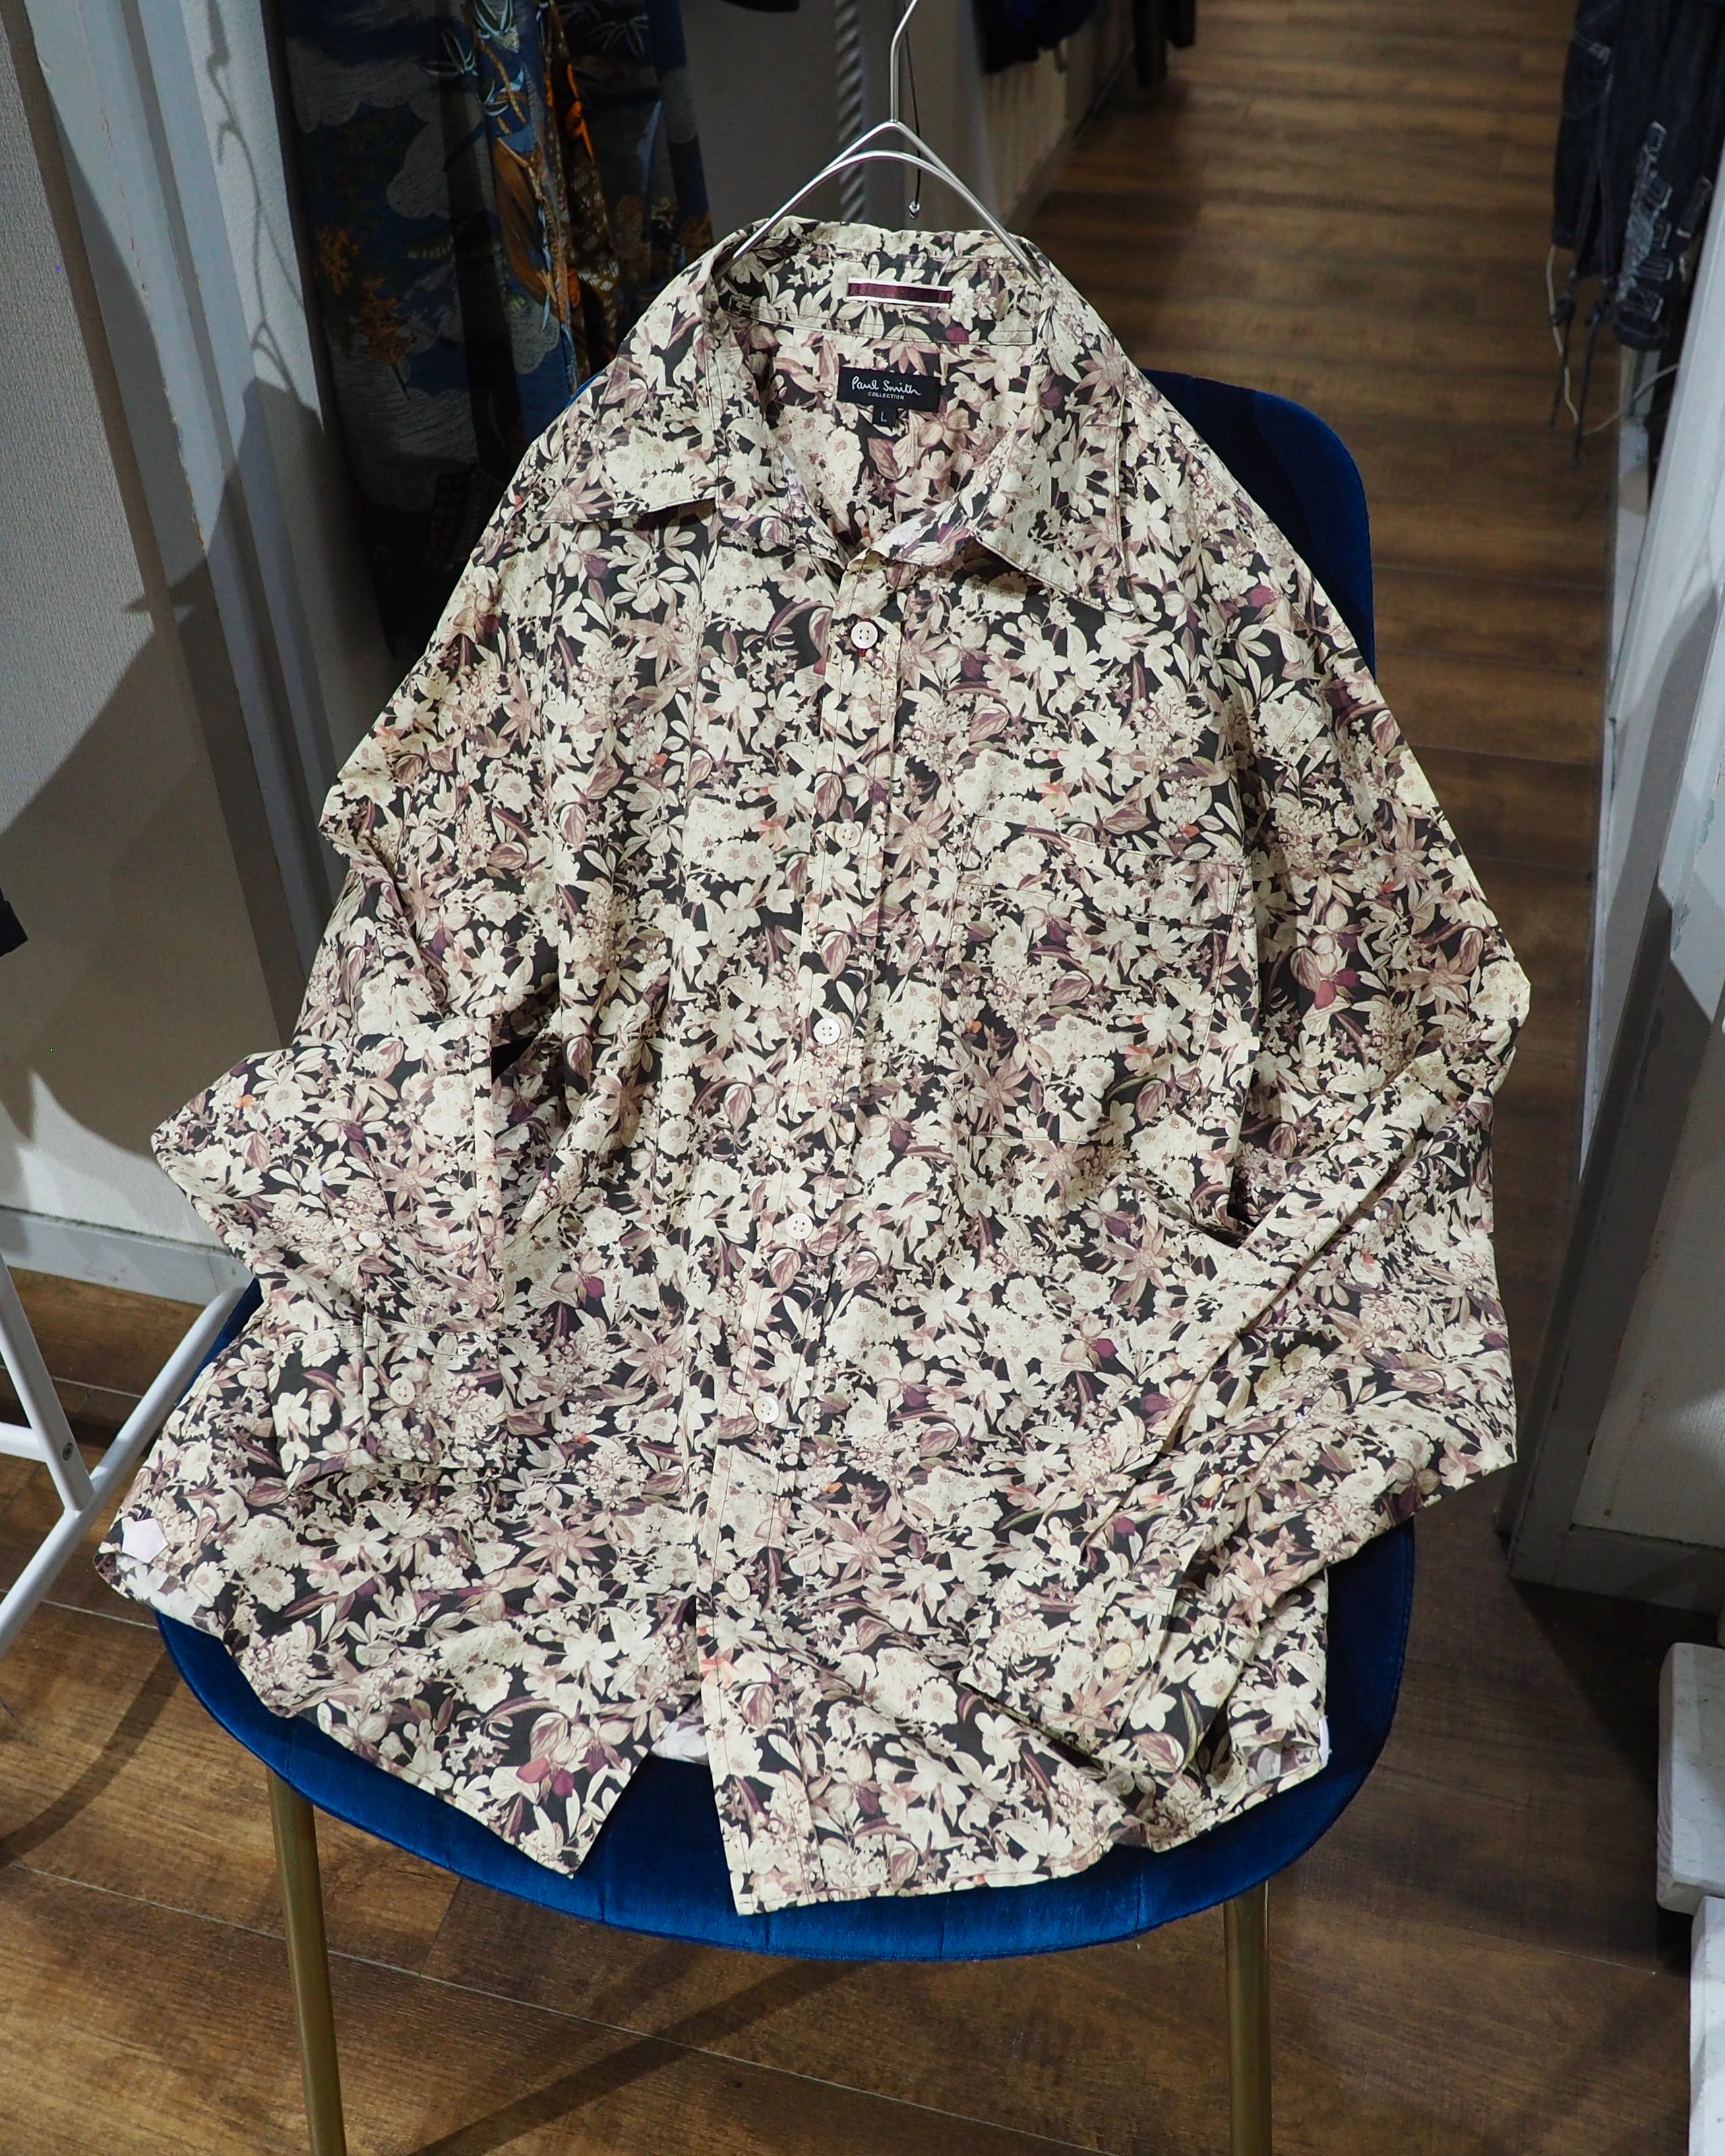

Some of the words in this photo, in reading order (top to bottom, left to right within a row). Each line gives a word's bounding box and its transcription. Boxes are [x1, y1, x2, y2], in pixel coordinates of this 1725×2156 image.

[851, 376, 880, 390] Paul
[883, 380, 921, 396] Smith
[868, 392, 905, 400] COLLECTION
[880, 411, 887, 422] L
